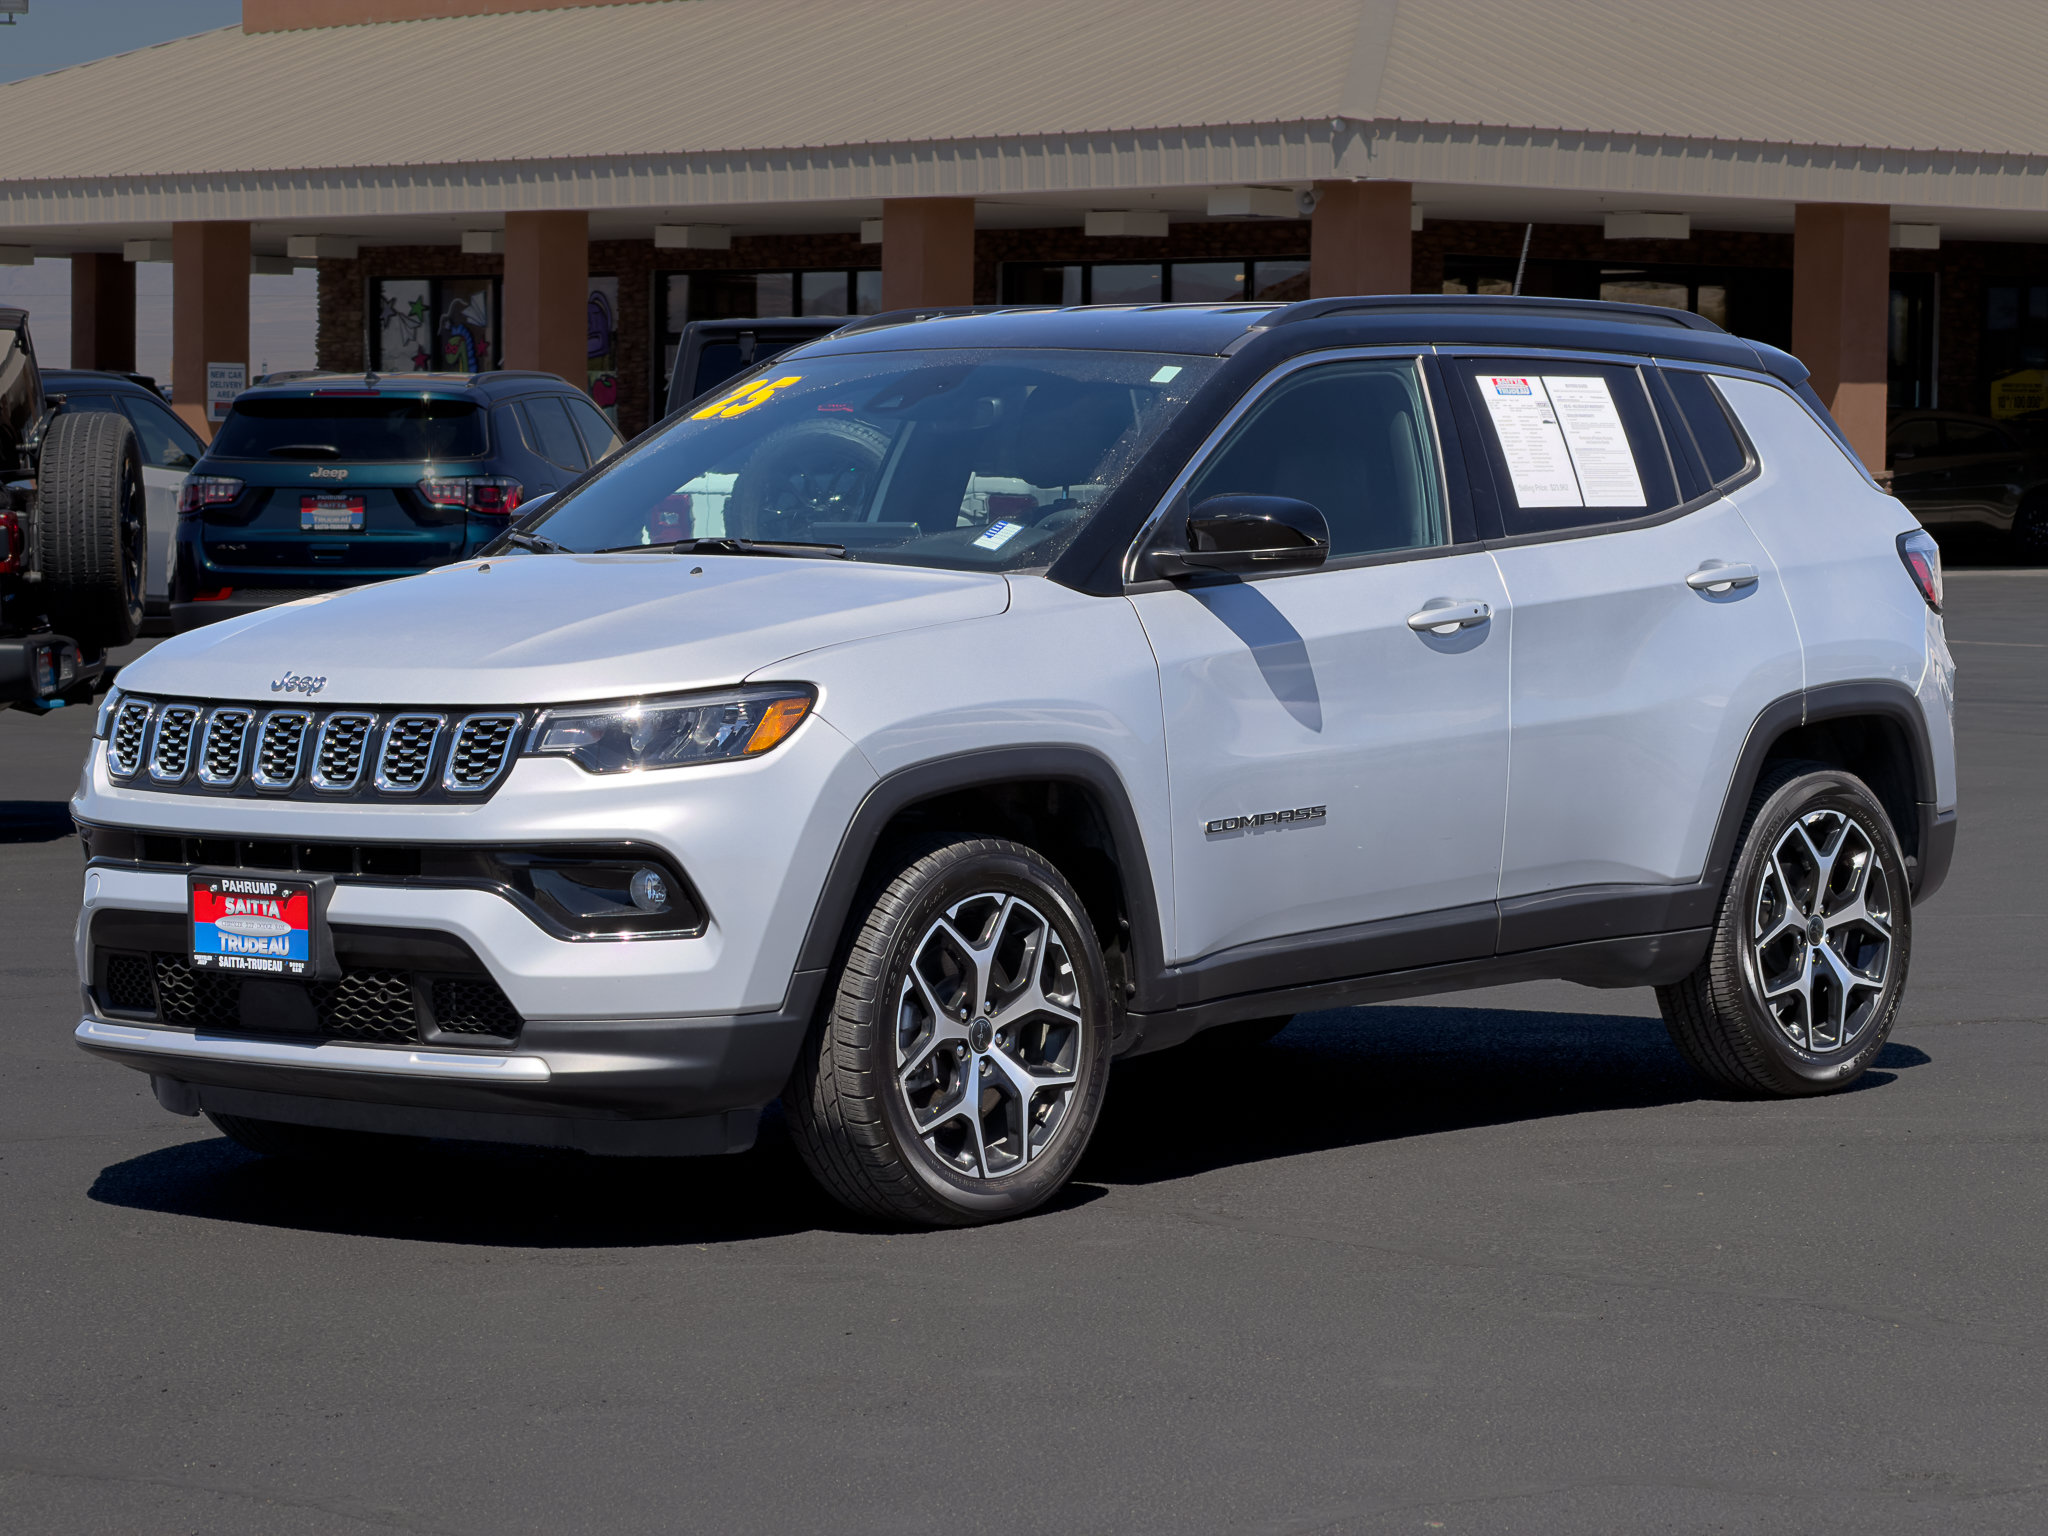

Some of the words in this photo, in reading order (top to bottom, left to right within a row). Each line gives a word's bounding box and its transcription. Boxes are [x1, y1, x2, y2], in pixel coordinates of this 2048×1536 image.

[210, 381, 243, 389] DELIVERY
[691, 376, 802, 420] 25
[310, 466, 349, 481] Jeep
[271, 671, 327, 697] Jeep
[1204, 805, 1327, 835] COMPASS
[221, 879, 278, 895] PAHRUMP
[224, 897, 281, 919] SAITTA
[217, 931, 290, 956] TRUDEAU
[218, 955, 283, 972] SAITTA-TRUDEAU
